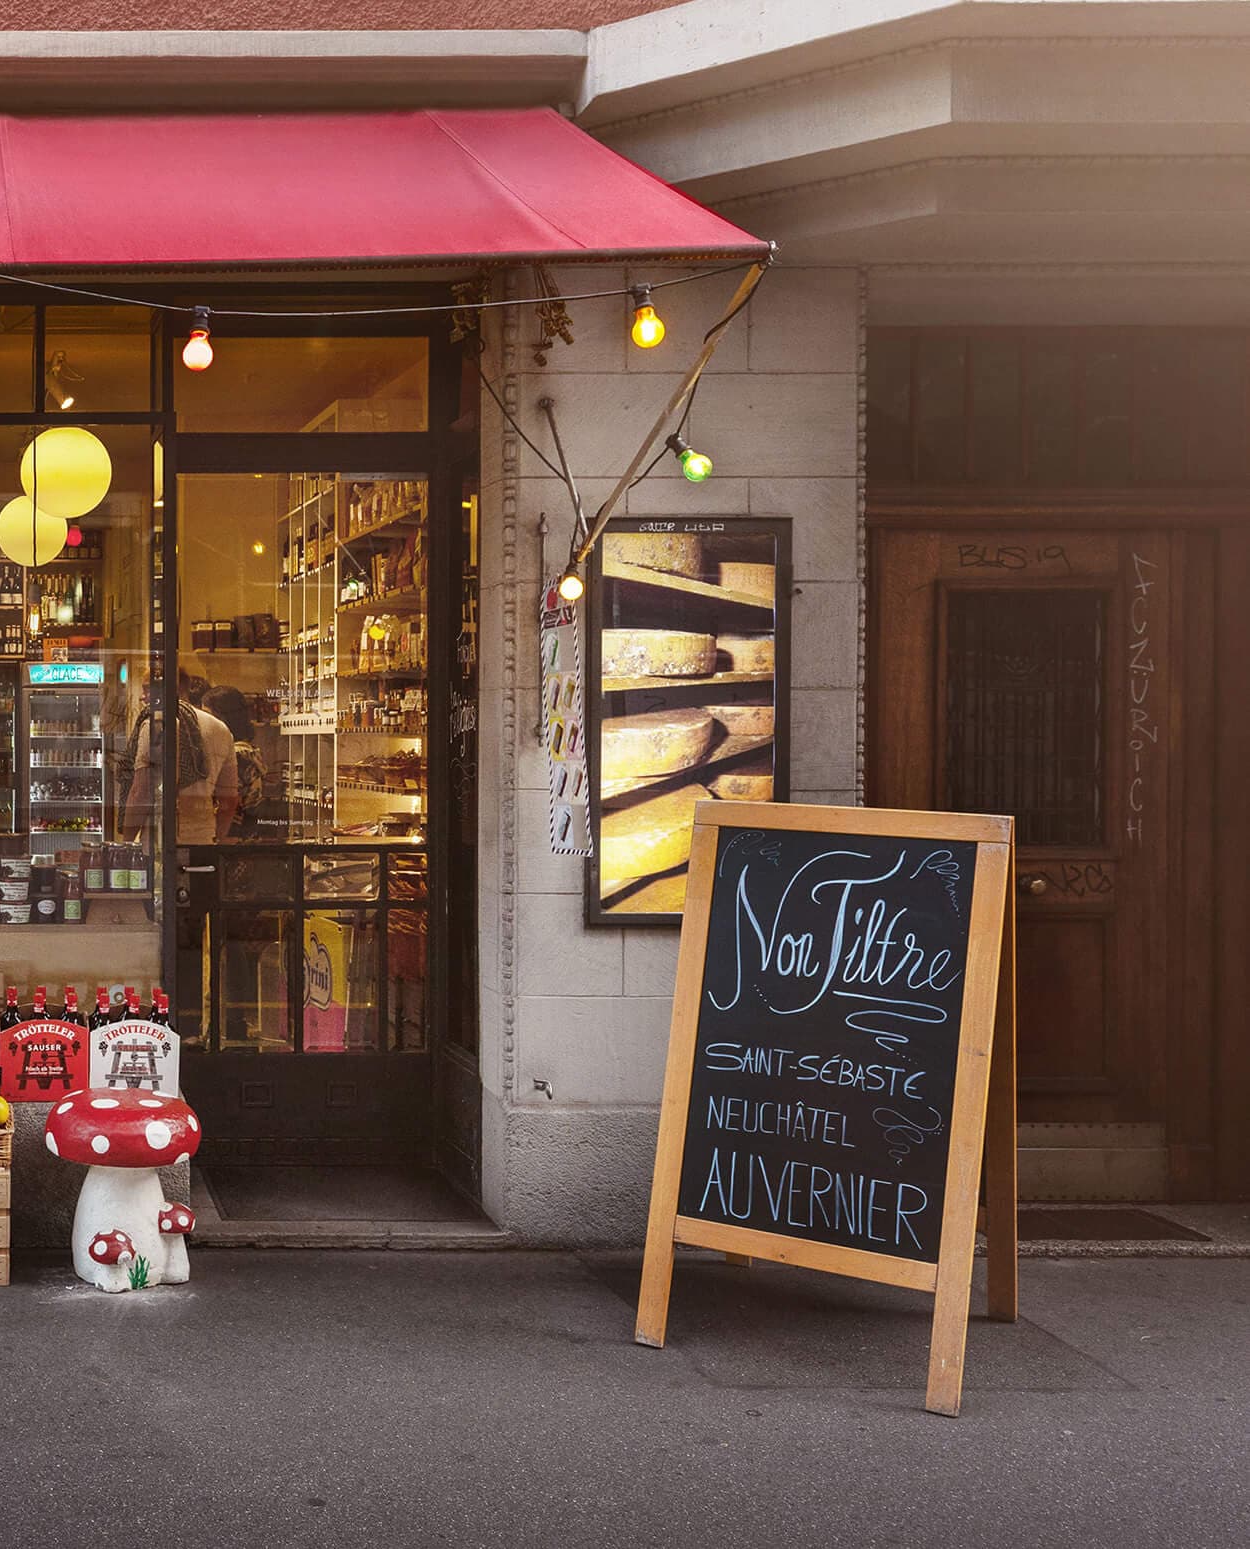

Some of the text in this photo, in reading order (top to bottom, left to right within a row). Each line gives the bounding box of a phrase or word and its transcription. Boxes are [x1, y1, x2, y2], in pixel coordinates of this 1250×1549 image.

[52, 667, 83, 681] GLACE
[707, 852, 845, 1010] Non
[14, 1024, 75, 1041] TRÖTTELER
[704, 1042, 927, 1101] SAINT-SÉBASTE
[706, 1095, 855, 1148] NEUCHÂTEL
[698, 1147, 929, 1250] AUVERNIER
